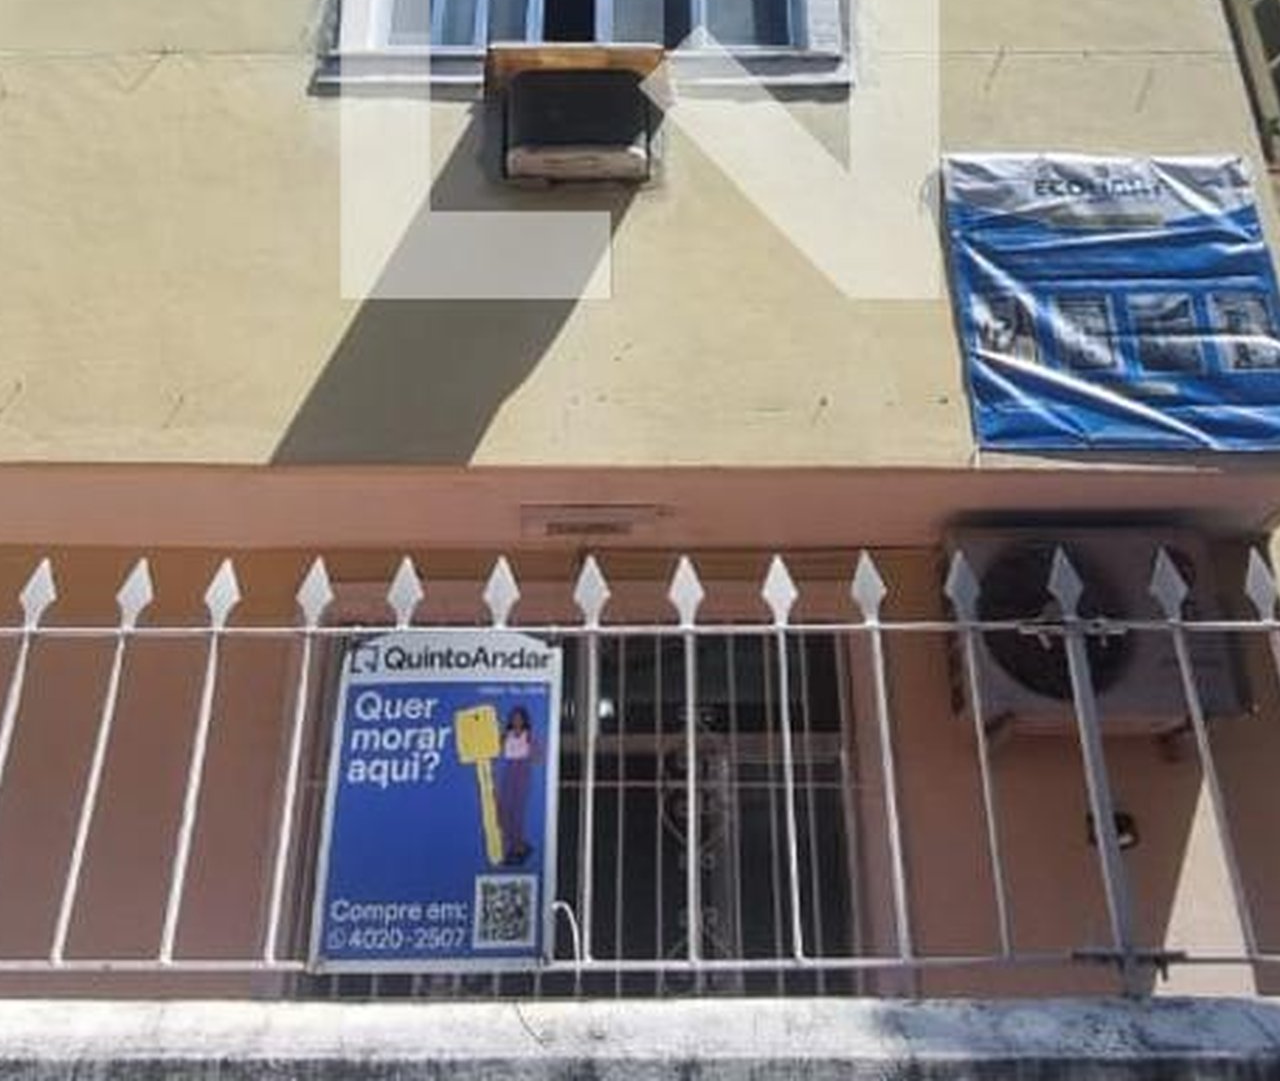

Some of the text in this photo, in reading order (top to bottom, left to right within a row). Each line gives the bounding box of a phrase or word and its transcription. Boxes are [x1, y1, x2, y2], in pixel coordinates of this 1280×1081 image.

[384, 645, 553, 670] QuintoAndar
[354, 691, 439, 722] Quer
[350, 725, 451, 751] morar
[347, 751, 440, 789] aqui?
[330, 899, 468, 926] Compre em:
[348, 926, 465, 950] 4020-2507
